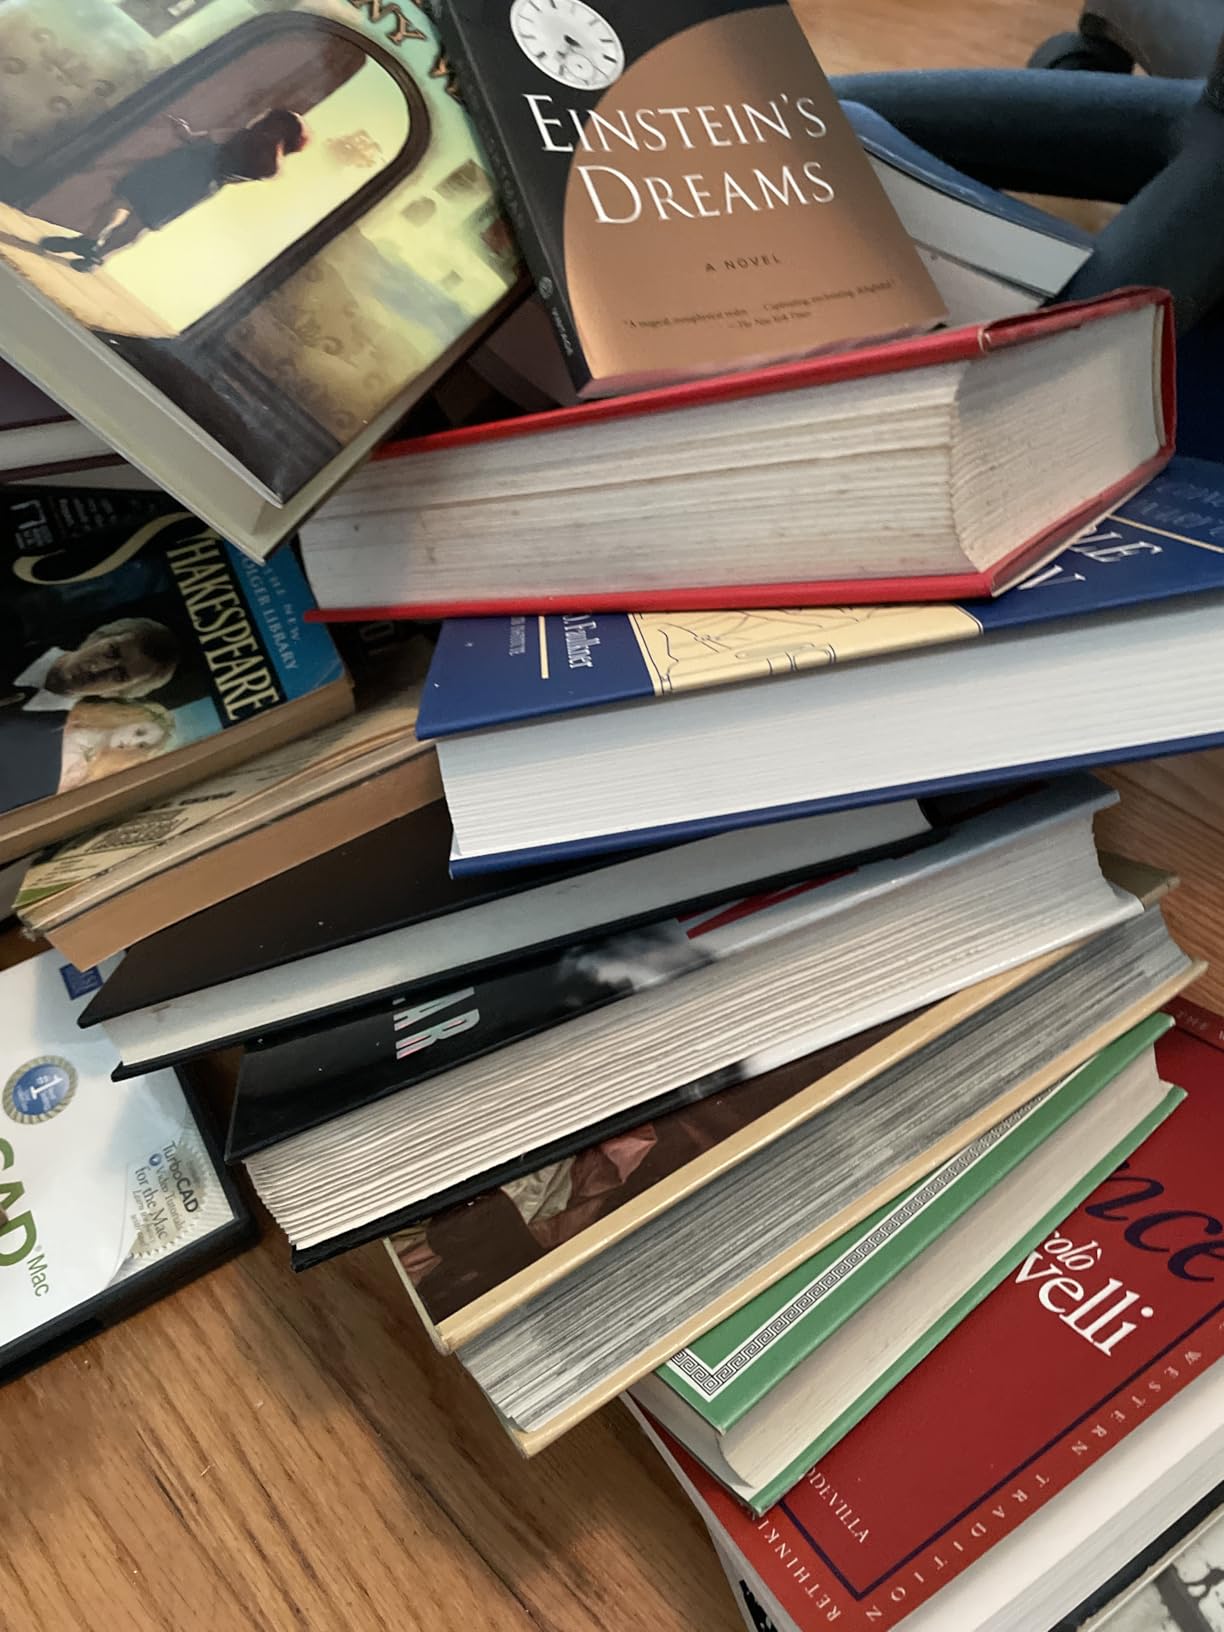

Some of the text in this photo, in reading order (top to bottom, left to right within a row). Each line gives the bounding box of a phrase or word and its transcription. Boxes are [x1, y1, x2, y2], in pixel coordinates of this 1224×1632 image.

[522, 93, 827, 153] EINSTEIN'S
[575, 161, 835, 224] DREAMS
[704, 254, 781, 273] A NOVEL
[263, 608, 299, 671] LIBRARY
[392, 987, 482, 1061] AR
[134, 1165, 151, 1187] for
[141, 1187, 159, 1210] the
[162, 1140, 200, 1213] TurboCAD
[149, 1207, 169, 1241] Mac
[1043, 1229, 1104, 1271] olò
[27, 1253, 50, 1298] Mac
[807, 1467, 870, 1544] DEVILLA
[865, 1350, 1203, 1623] WESTERN TRADITION
